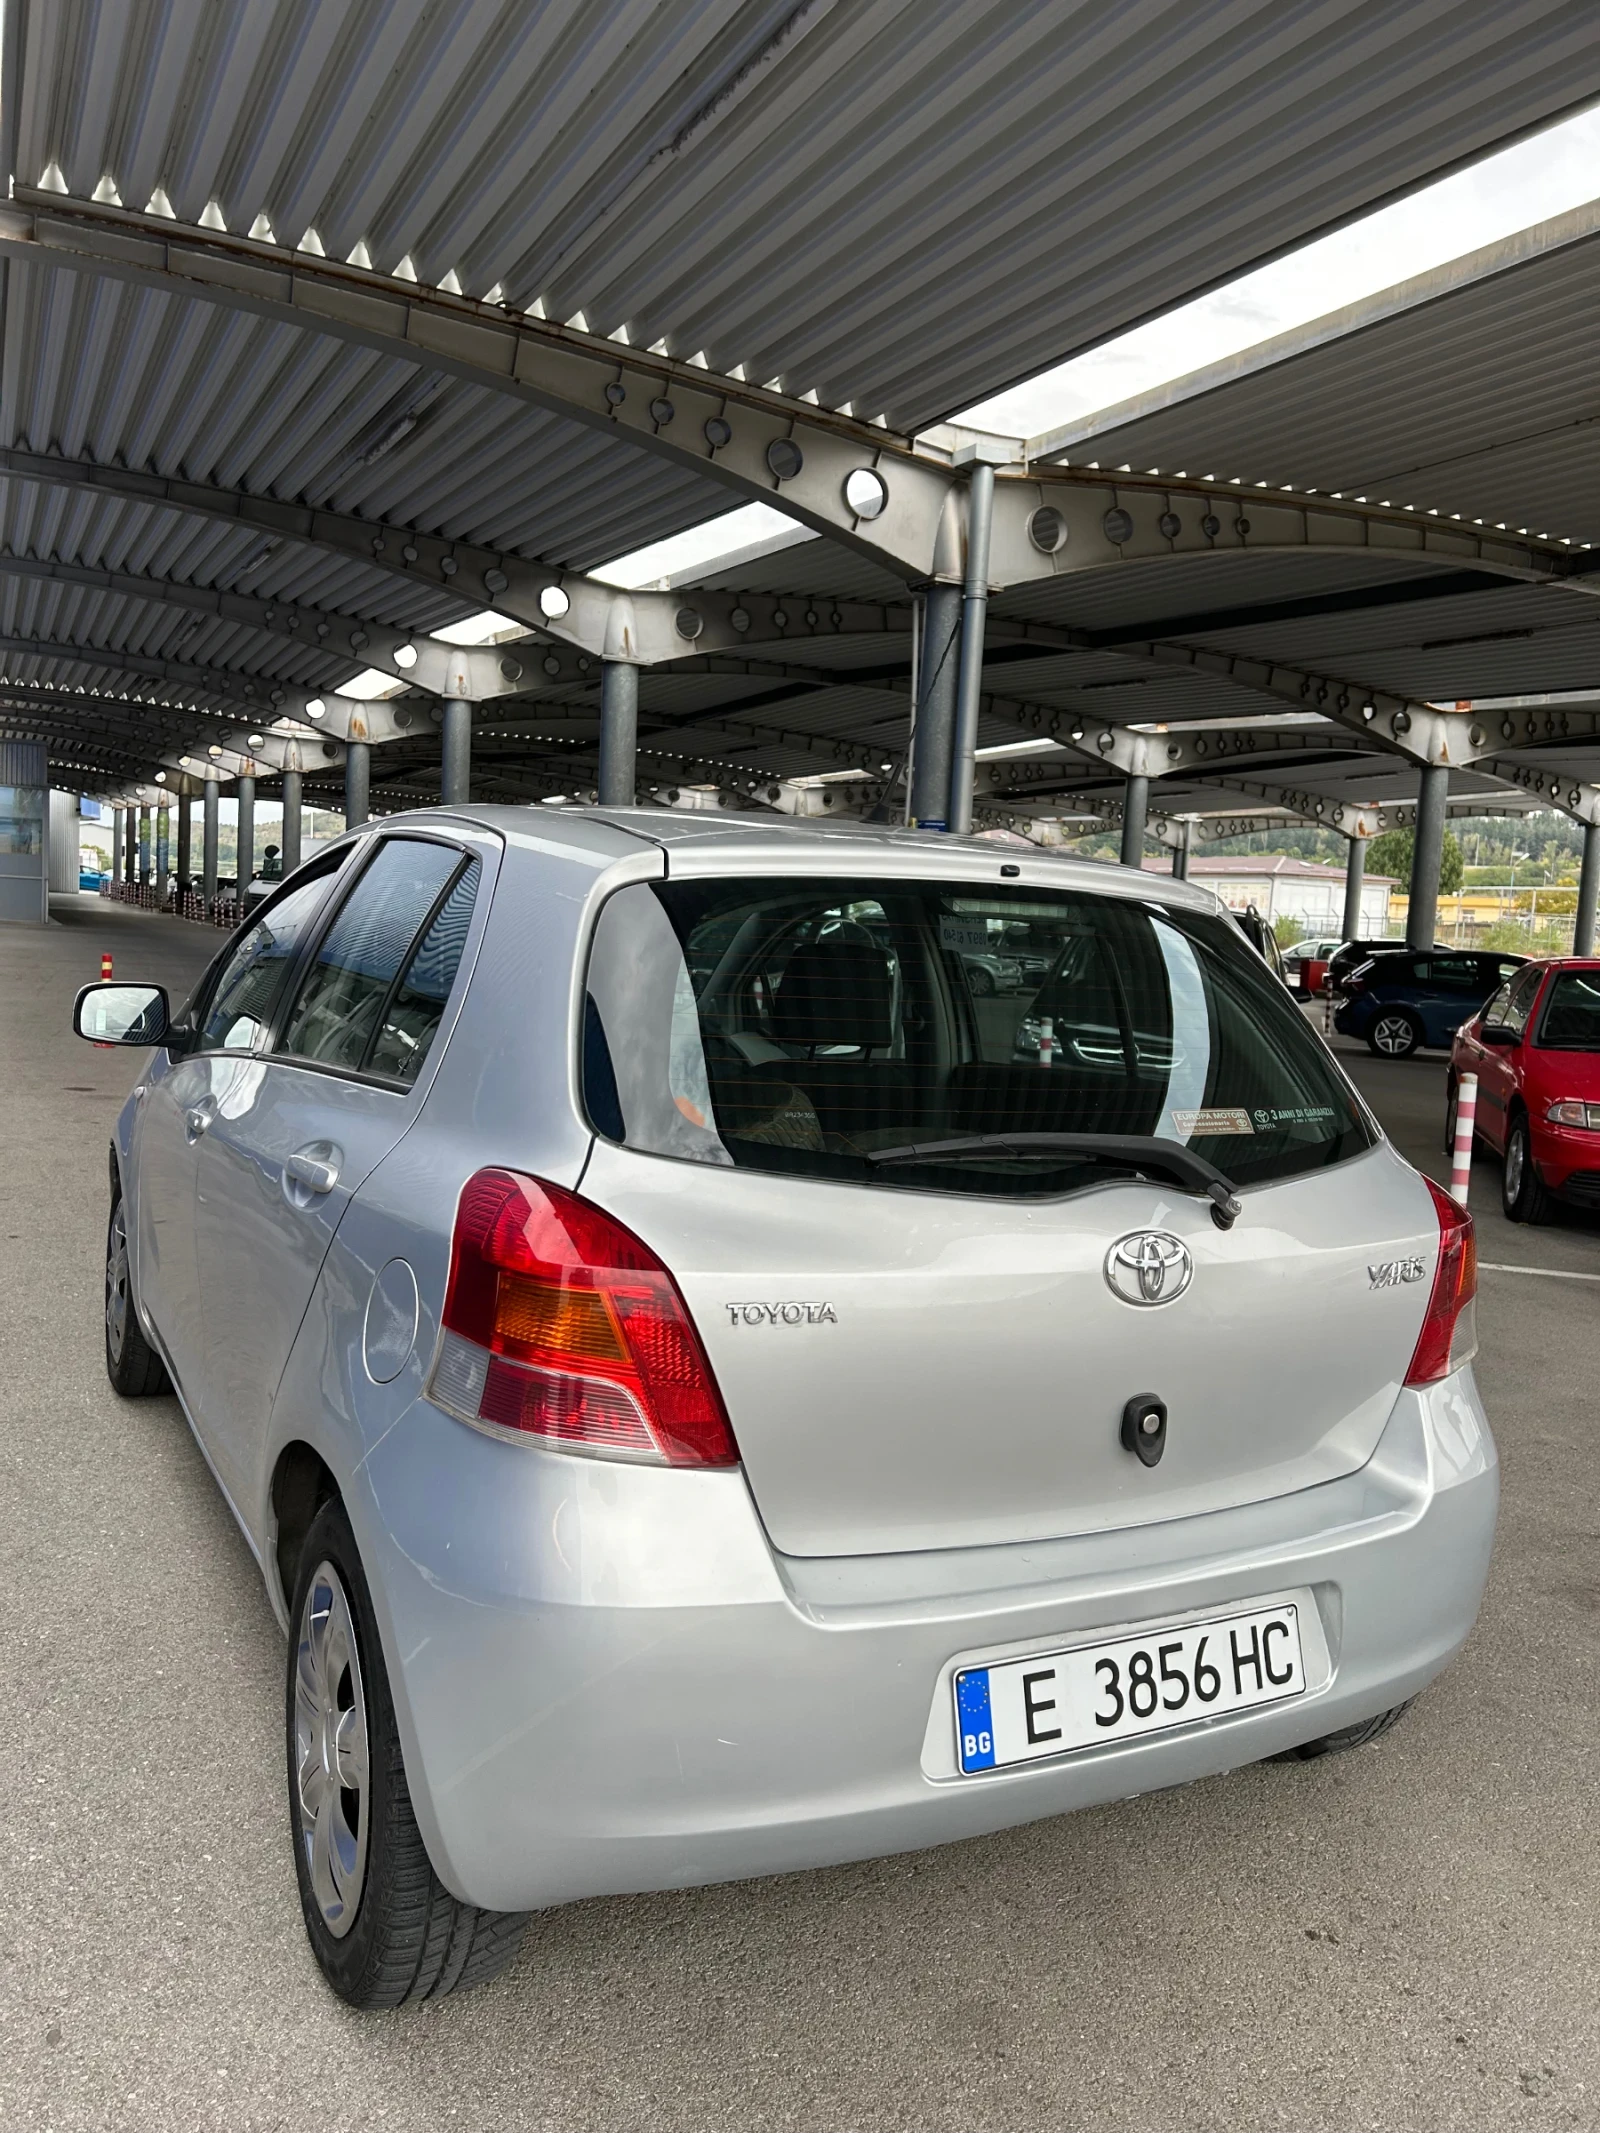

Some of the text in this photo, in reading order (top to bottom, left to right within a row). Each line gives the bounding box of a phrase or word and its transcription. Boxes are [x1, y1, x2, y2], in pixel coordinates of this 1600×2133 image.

[1177, 1111, 1246, 1121] EUROPA MOTORI
[1270, 1108, 1279, 1121] 3
[1278, 1109, 1296, 1120] ANNI
[1295, 1108, 1305, 1118] DI
[1303, 1106, 1336, 1117] GARANZIA
[1256, 1123, 1277, 1131] TOYOTA
[726, 1301, 838, 1325] TOYOTA
[1022, 1620, 1293, 1745] E 3856 HC
[964, 1731, 991, 1757] BG
